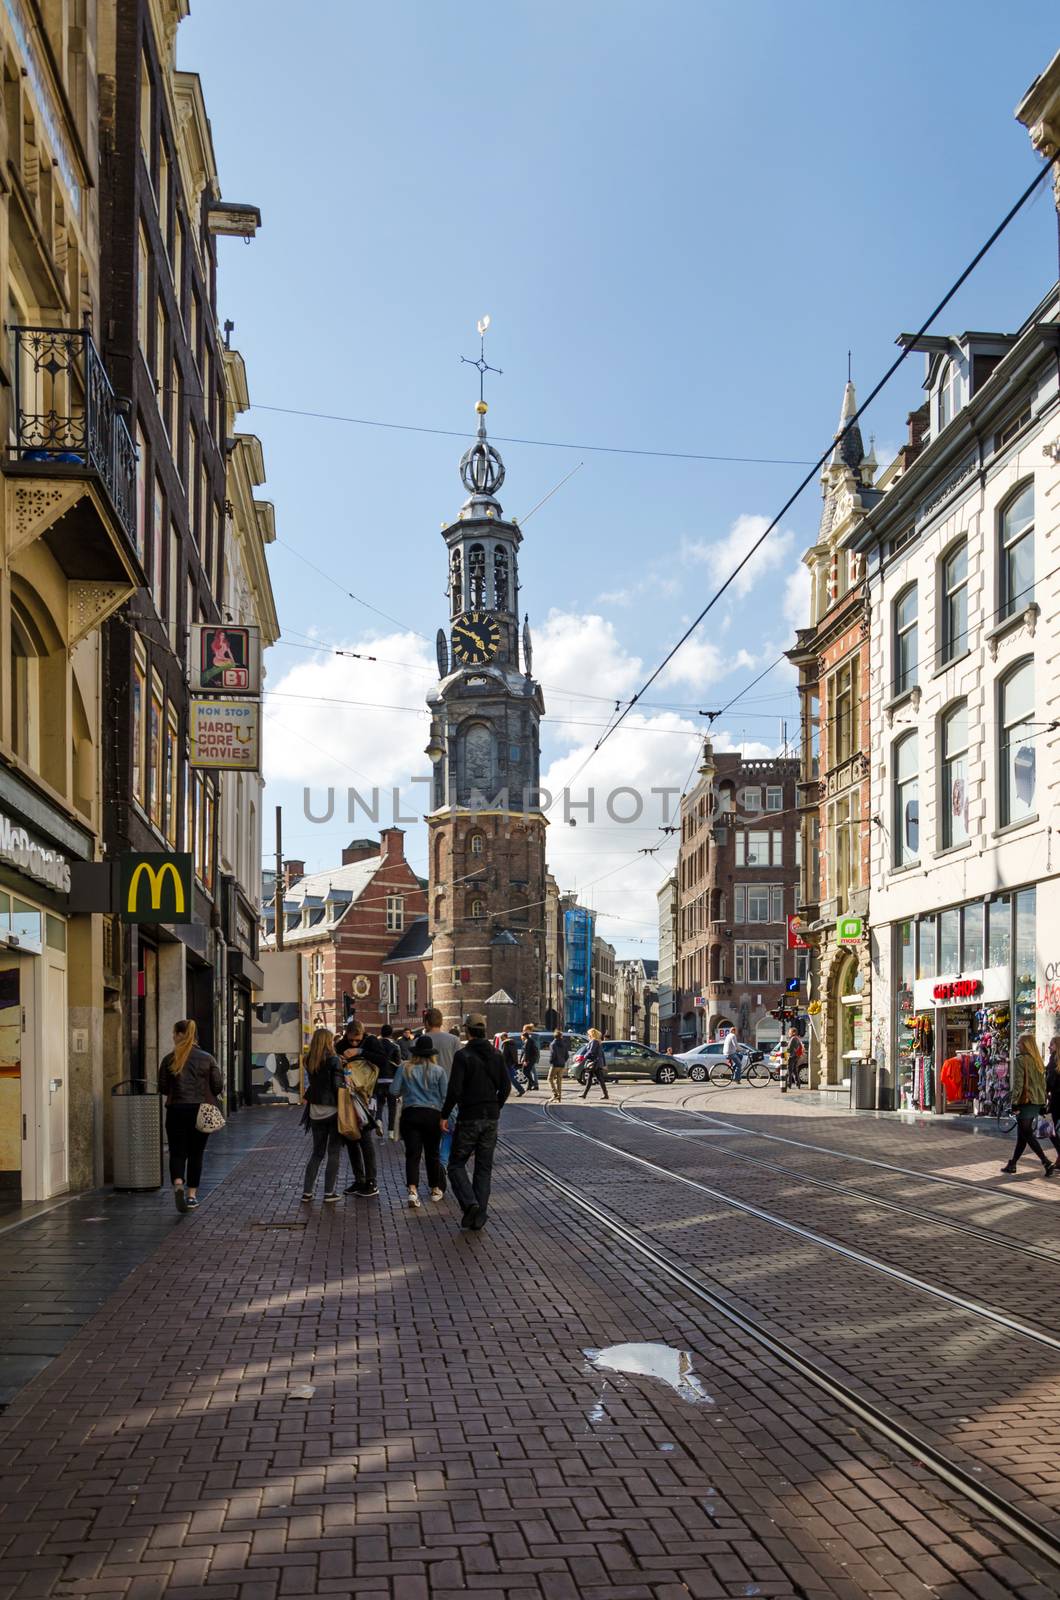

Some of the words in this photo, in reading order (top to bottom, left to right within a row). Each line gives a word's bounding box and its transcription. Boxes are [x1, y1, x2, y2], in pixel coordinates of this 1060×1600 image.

[225, 670, 247, 686] B1
[198, 707, 221, 717] NON
[225, 708, 250, 718] STOP
[198, 722, 233, 733] HARD
[198, 734, 233, 746] CORE
[198, 747, 250, 759] MOVIES
[933, 982, 951, 1000] GIFT
[952, 979, 978, 997] SHOP
